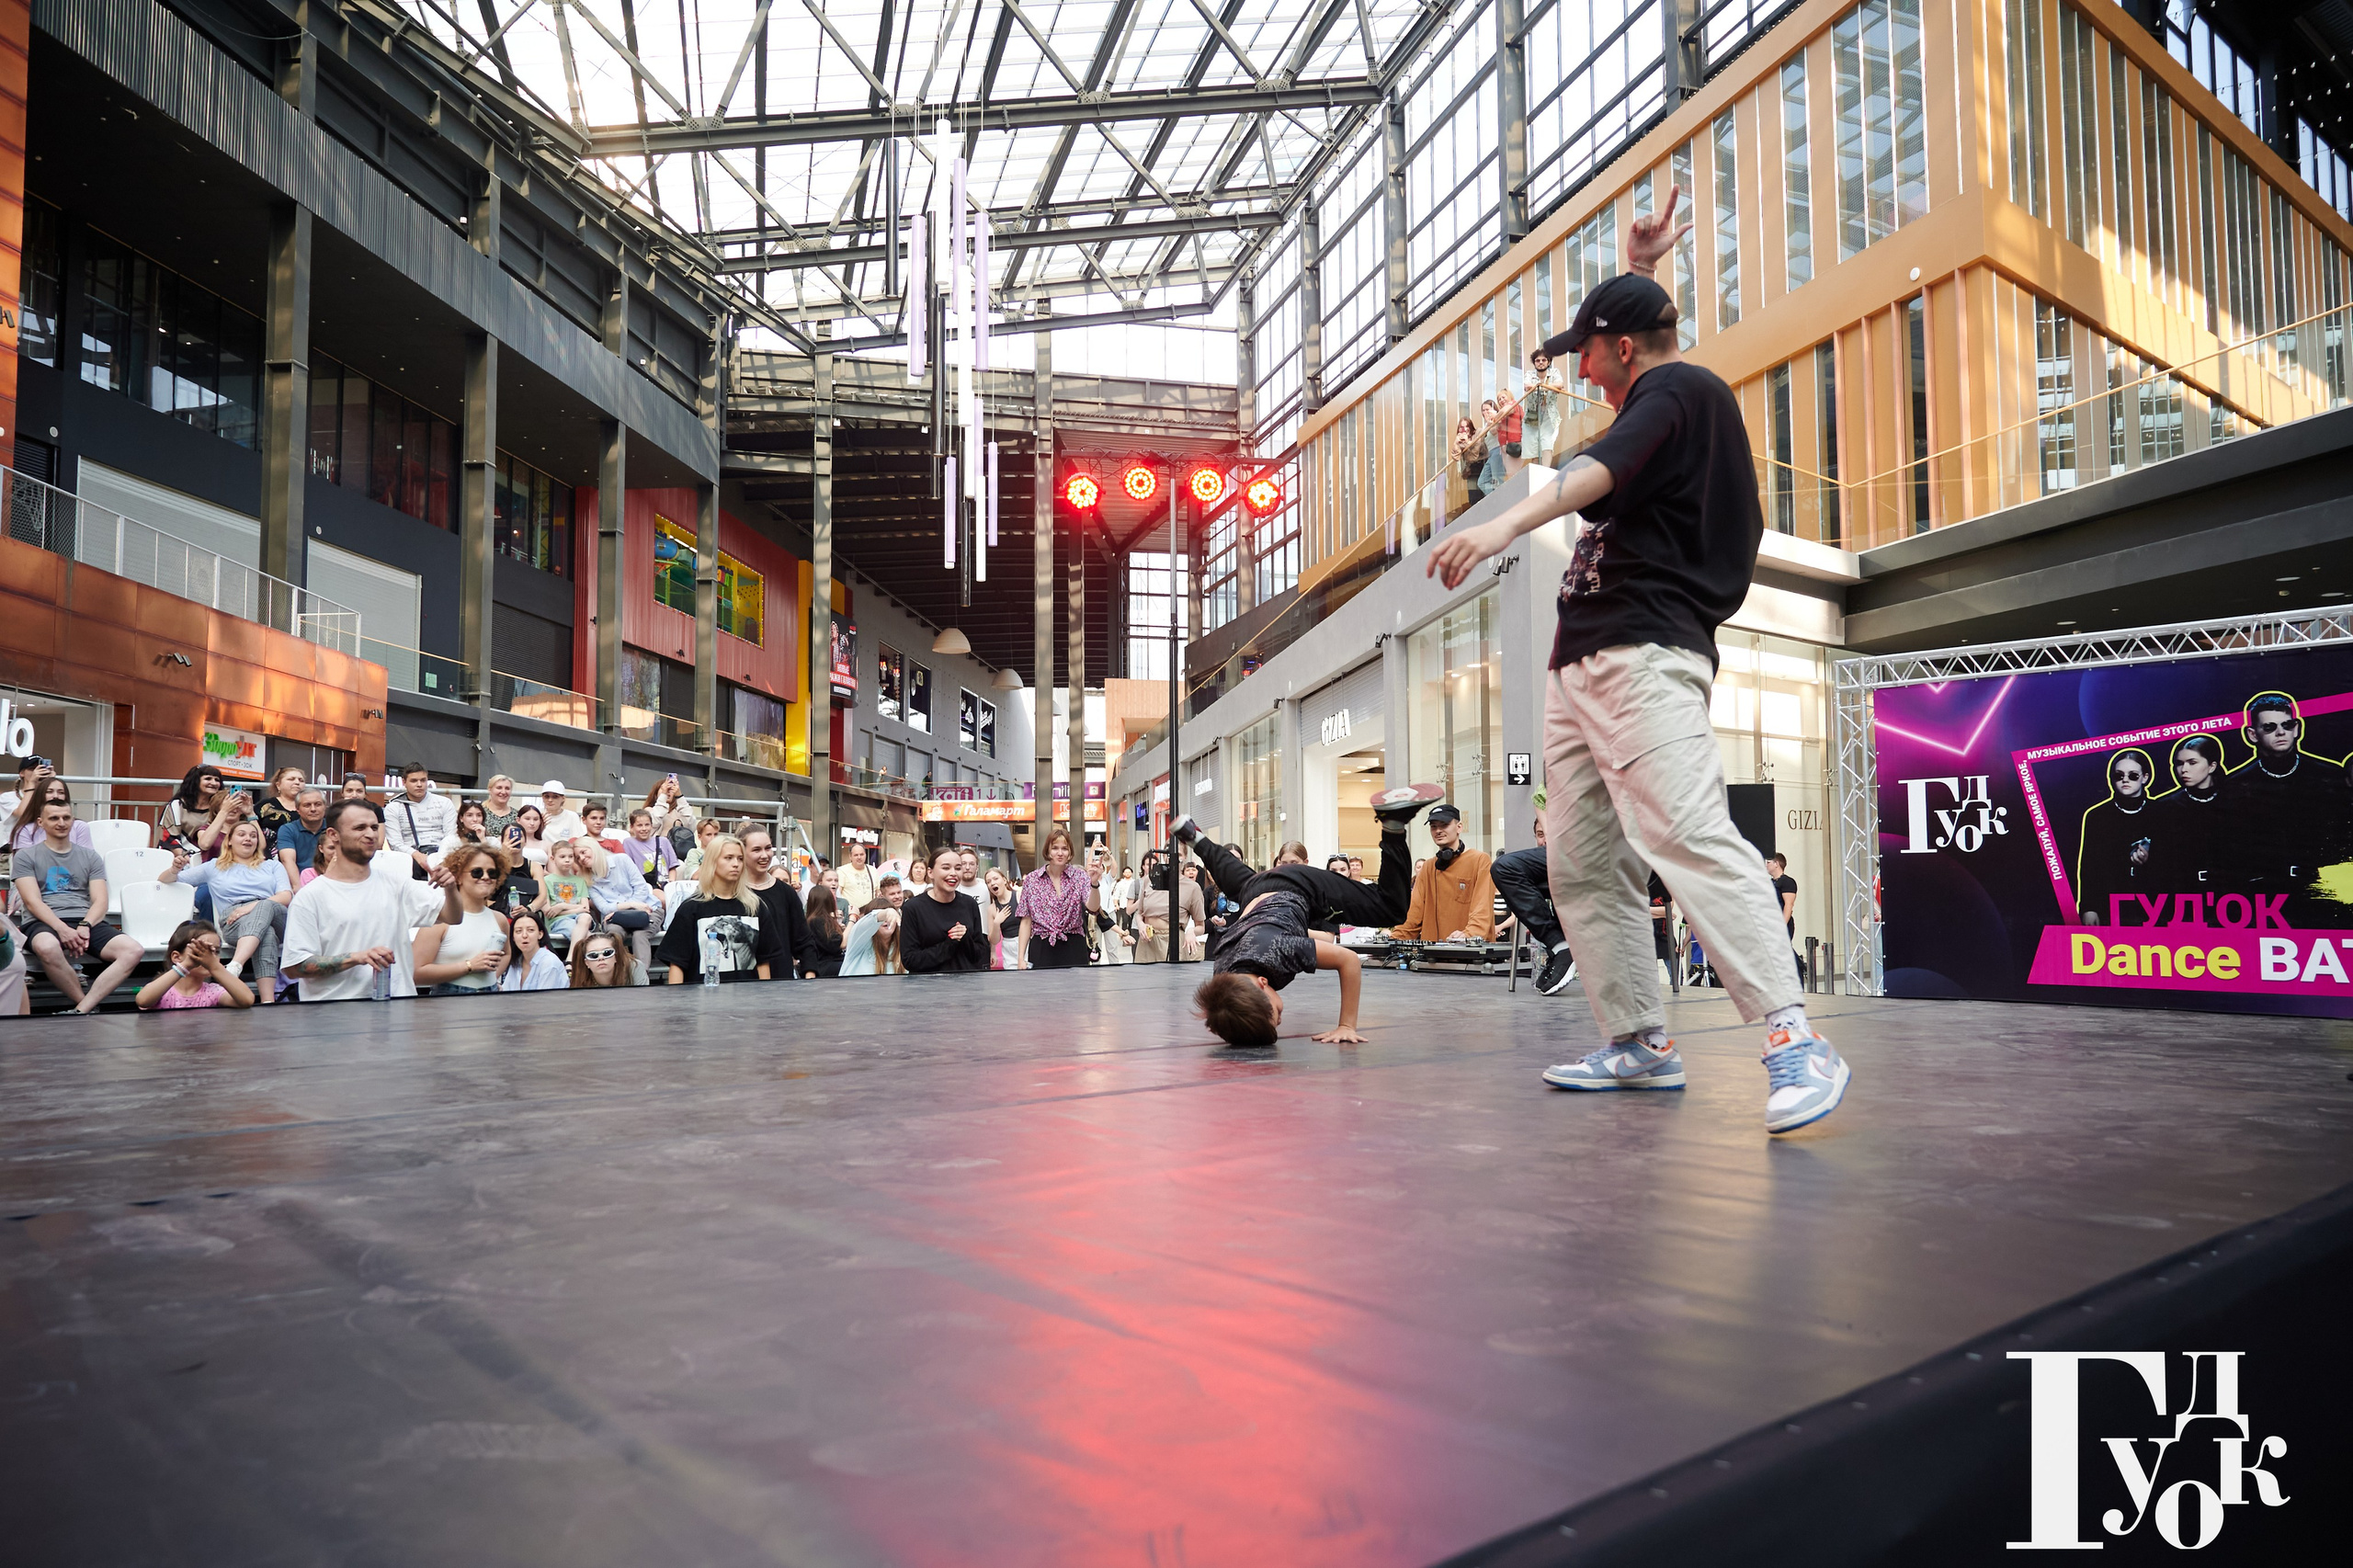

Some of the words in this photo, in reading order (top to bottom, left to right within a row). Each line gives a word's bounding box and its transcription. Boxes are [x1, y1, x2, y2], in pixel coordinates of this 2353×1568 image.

[2027, 739, 2107, 760] МУЗЫКАЛЬНОЕ
[2108, 729, 2161, 746] СОБЫТИЕ
[2163, 722, 2199, 736] ЭТОГО
[2201, 717, 2233, 730] ЛЕТА
[2018, 759, 2035, 793] ЯРКОЕ,
[963, 804, 1026, 819] Галамарт
[2028, 792, 2045, 827] САМОЕ
[2039, 827, 2063, 881] ПОЖАЛУЙ,
[2109, 892, 2292, 930] ГУД'ОК
[2071, 933, 2241, 980] Dance
